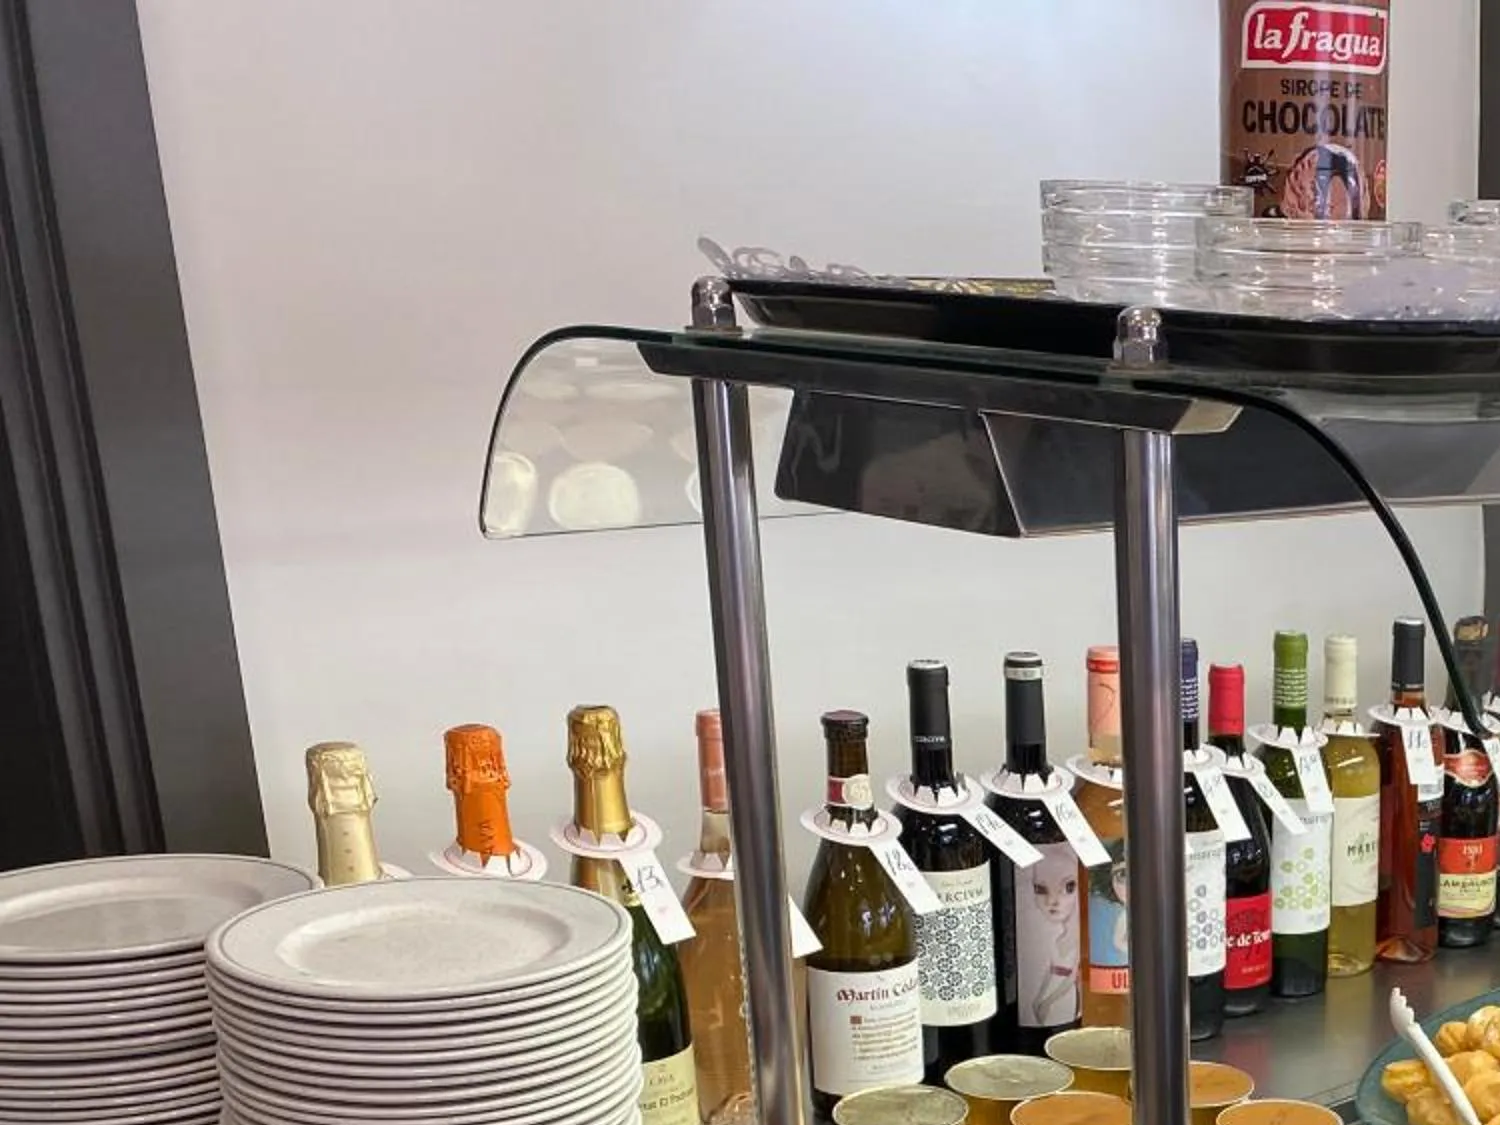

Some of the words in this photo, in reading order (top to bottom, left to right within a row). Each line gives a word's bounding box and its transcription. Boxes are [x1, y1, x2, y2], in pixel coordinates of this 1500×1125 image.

[1254, 13, 1283, 49] la
[1281, 11, 1381, 61] fragua
[1280, 79, 1340, 98] SIROPE
[1344, 82, 1363, 100] DE
[1241, 100, 1385, 139] CHOCOLATE
